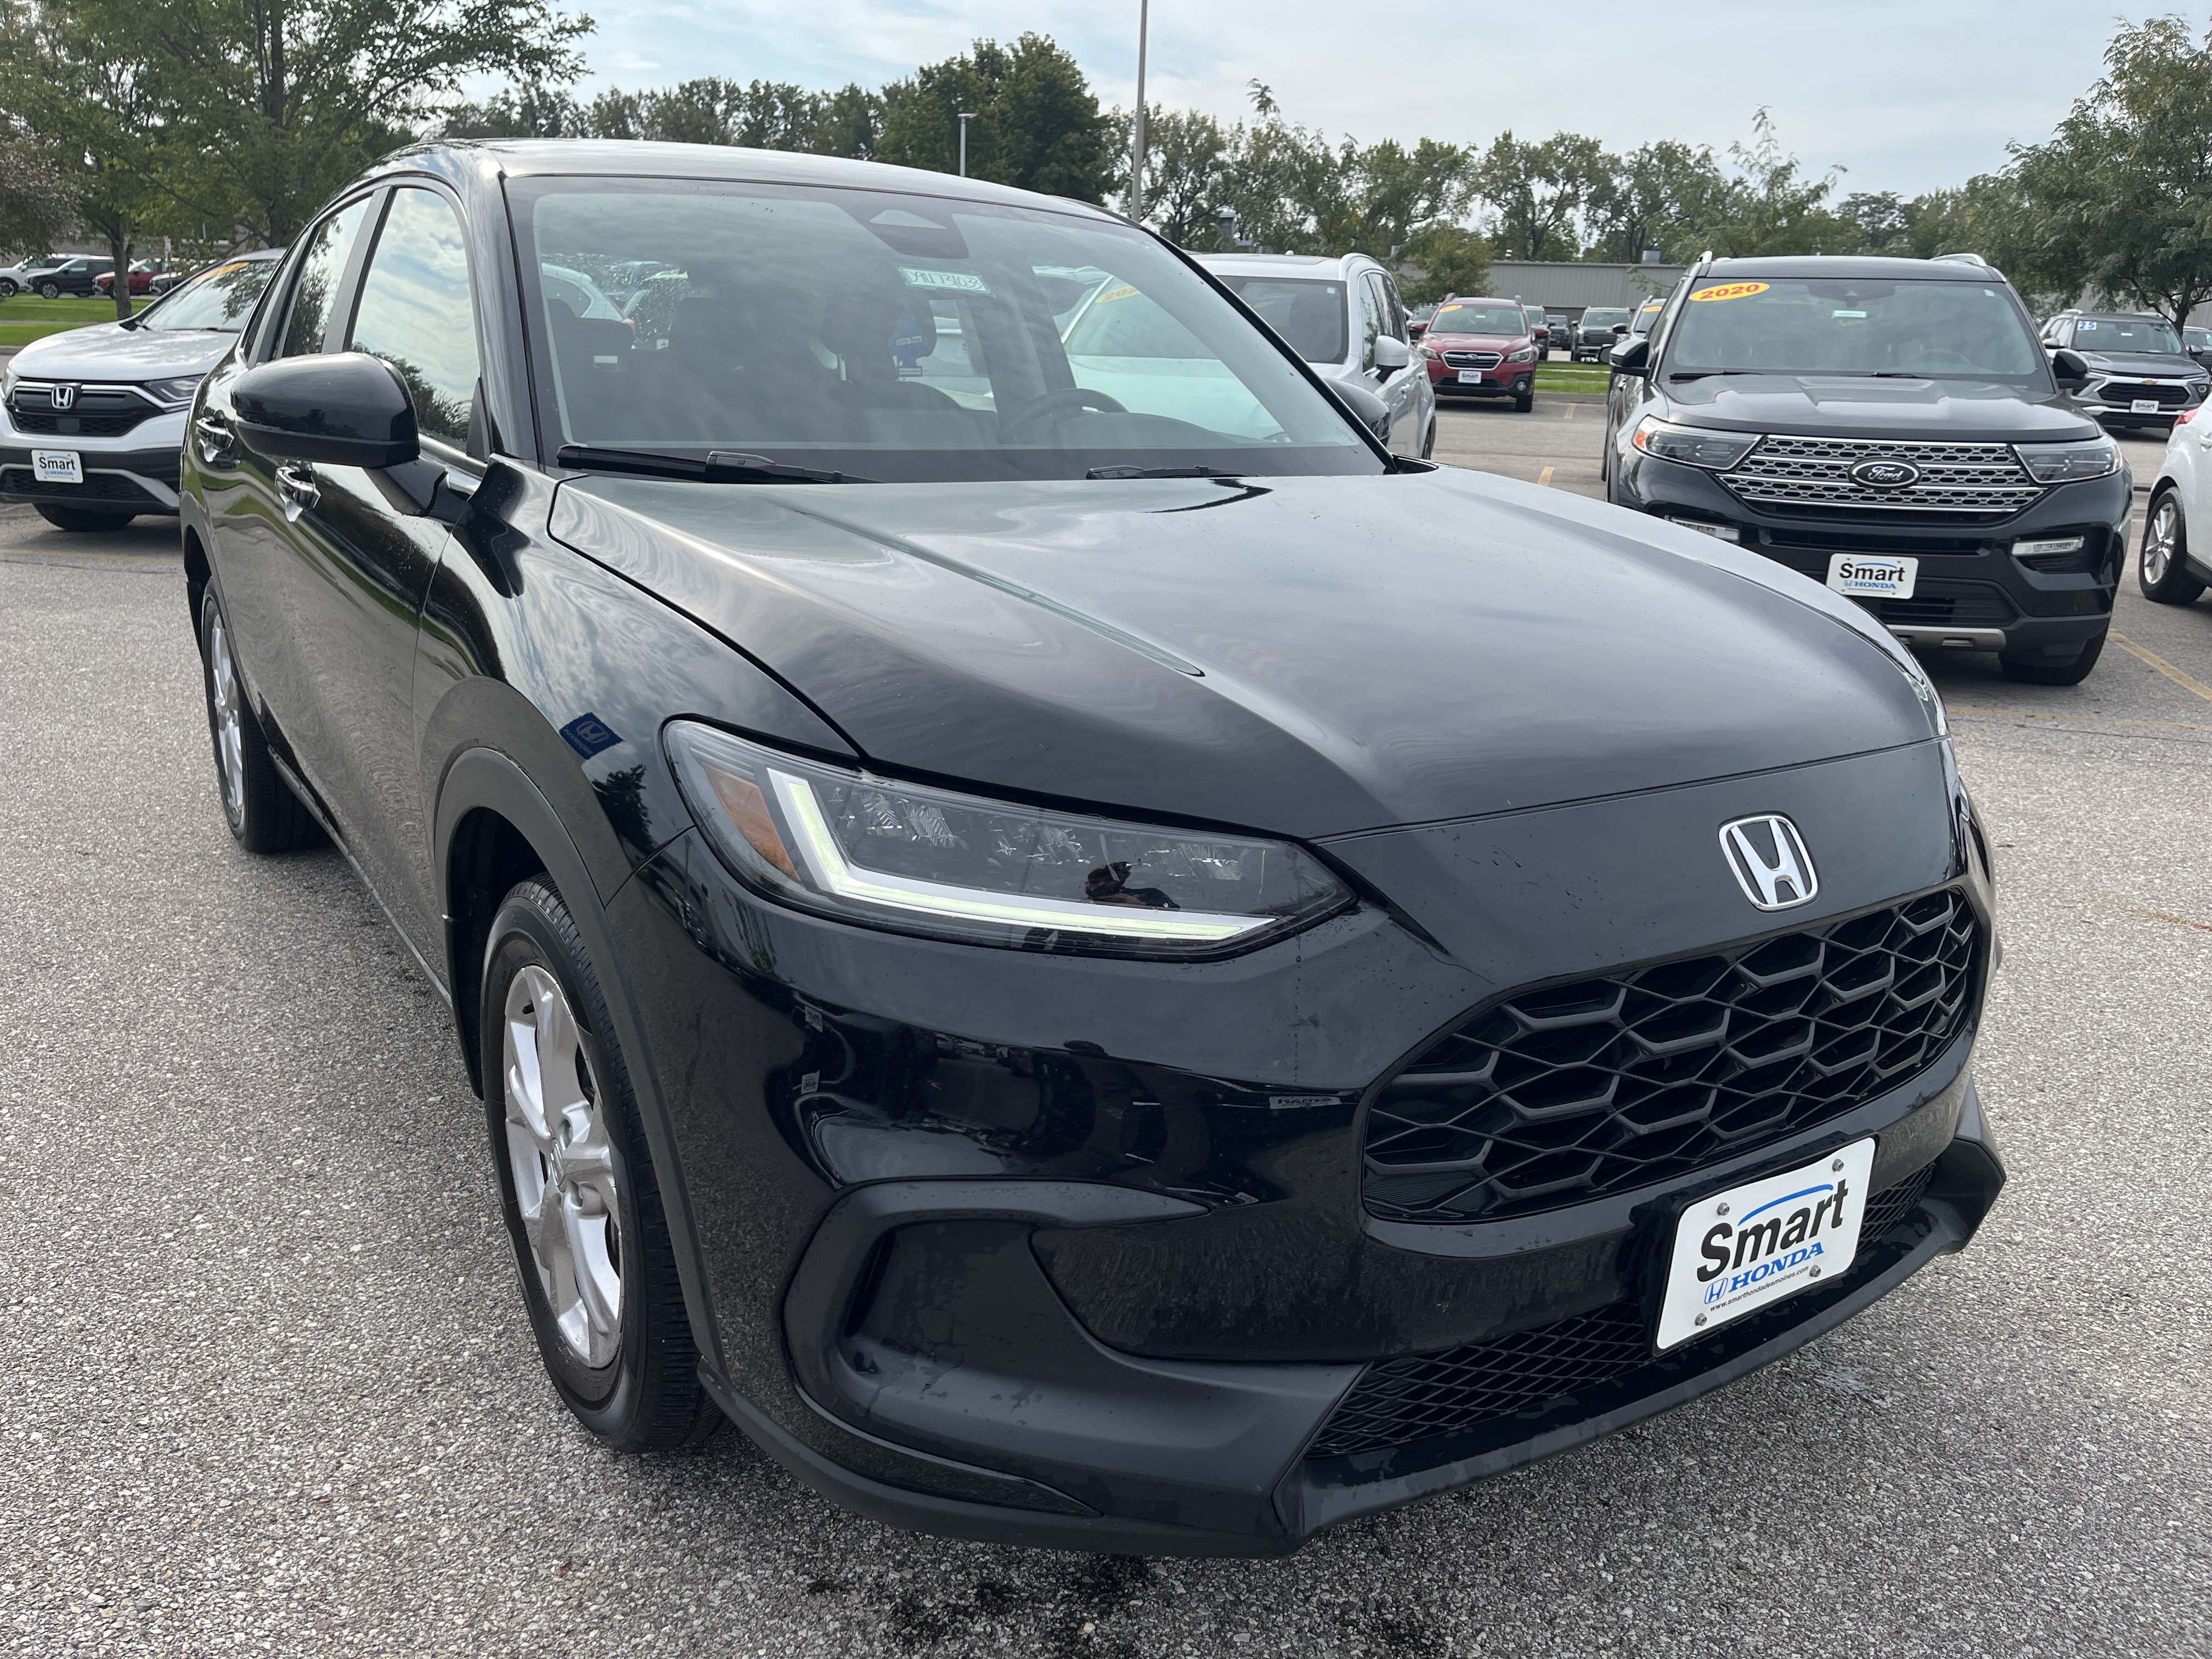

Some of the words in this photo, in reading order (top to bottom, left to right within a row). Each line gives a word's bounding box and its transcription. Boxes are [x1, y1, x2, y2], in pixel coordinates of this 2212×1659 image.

[1700, 284, 1759, 300] 2020
[39, 456, 76, 470] Smart
[1867, 466, 1904, 481] Ford
[1839, 562, 1906, 582] Smart
[1854, 580, 1897, 589] HONDA
[1696, 1178, 1849, 1283] Smart
[1728, 1241, 1825, 1294] HONDA
[1709, 1266, 1809, 1312] www.smarthondadesmoines.com
